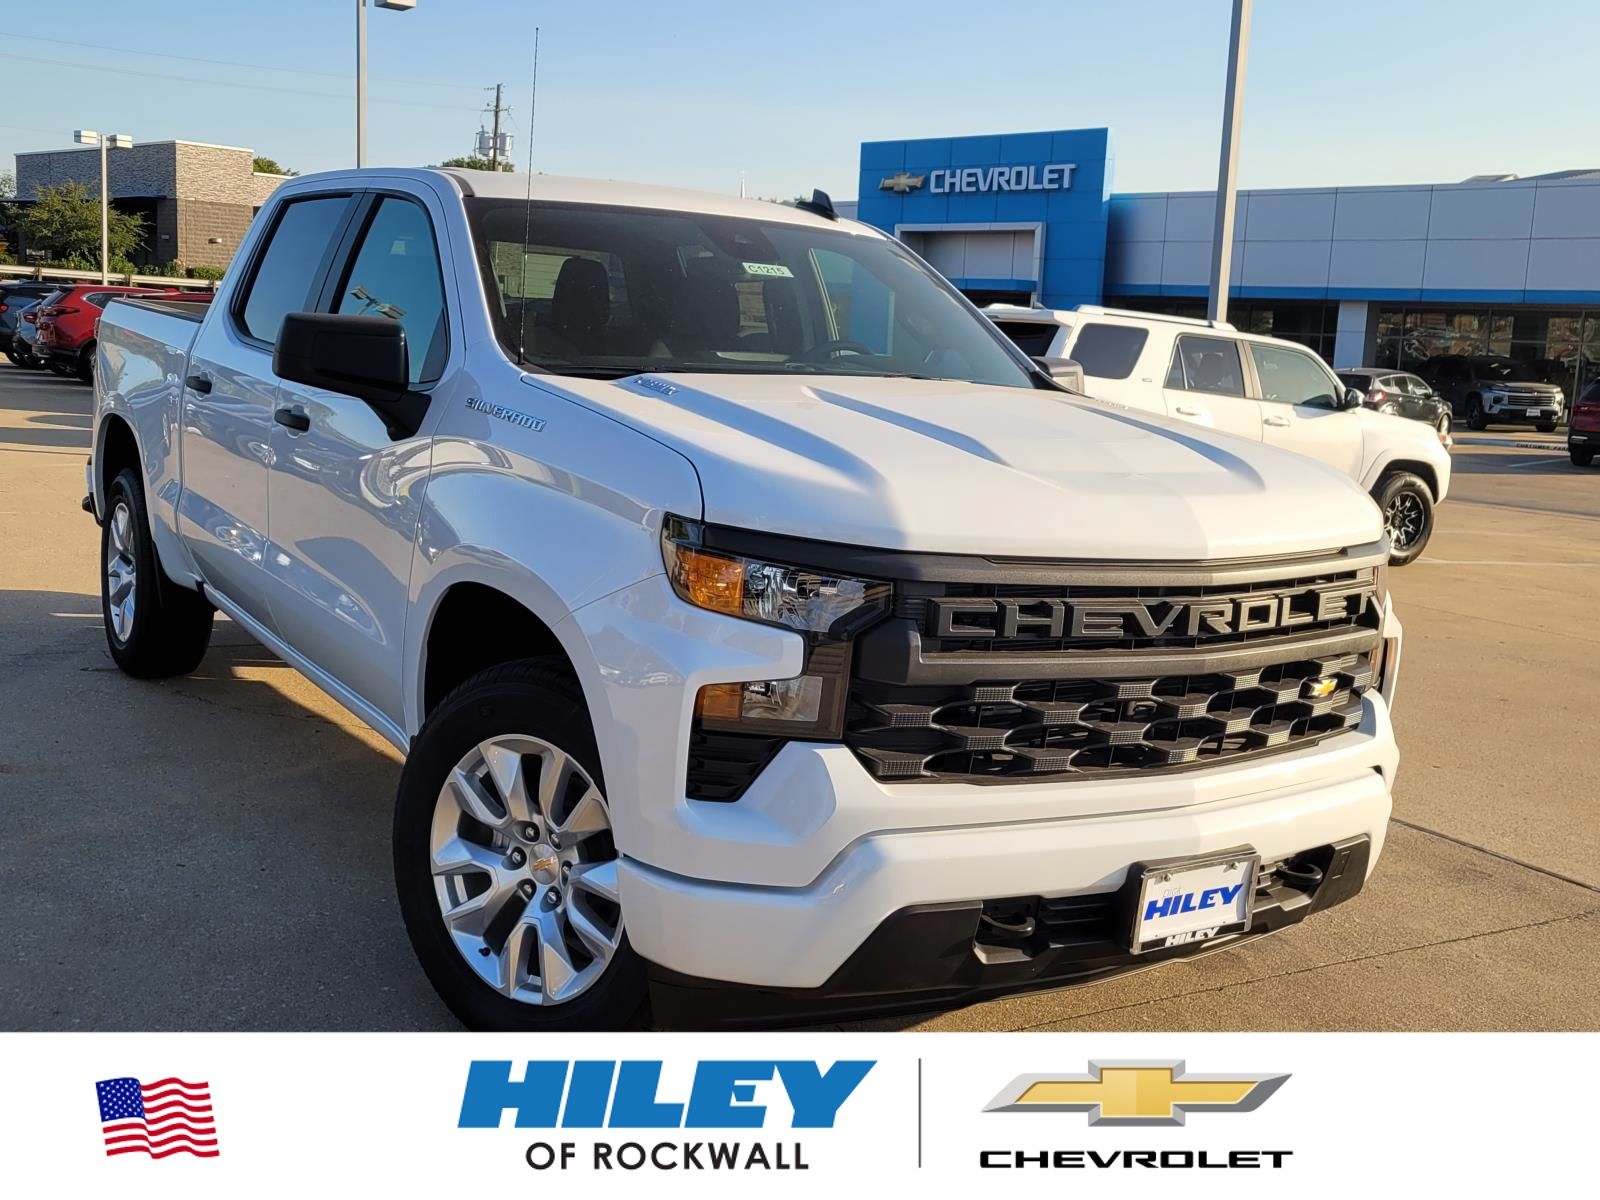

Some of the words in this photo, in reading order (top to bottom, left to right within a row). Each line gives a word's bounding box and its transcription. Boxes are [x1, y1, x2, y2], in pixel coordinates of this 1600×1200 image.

[929, 163, 1077, 194] CHEVROLET
[748, 264, 785, 275] C1215
[465, 397, 546, 432] SILVERADO
[1143, 883, 1244, 921] HILEY
[1164, 926, 1220, 948] HILEY
